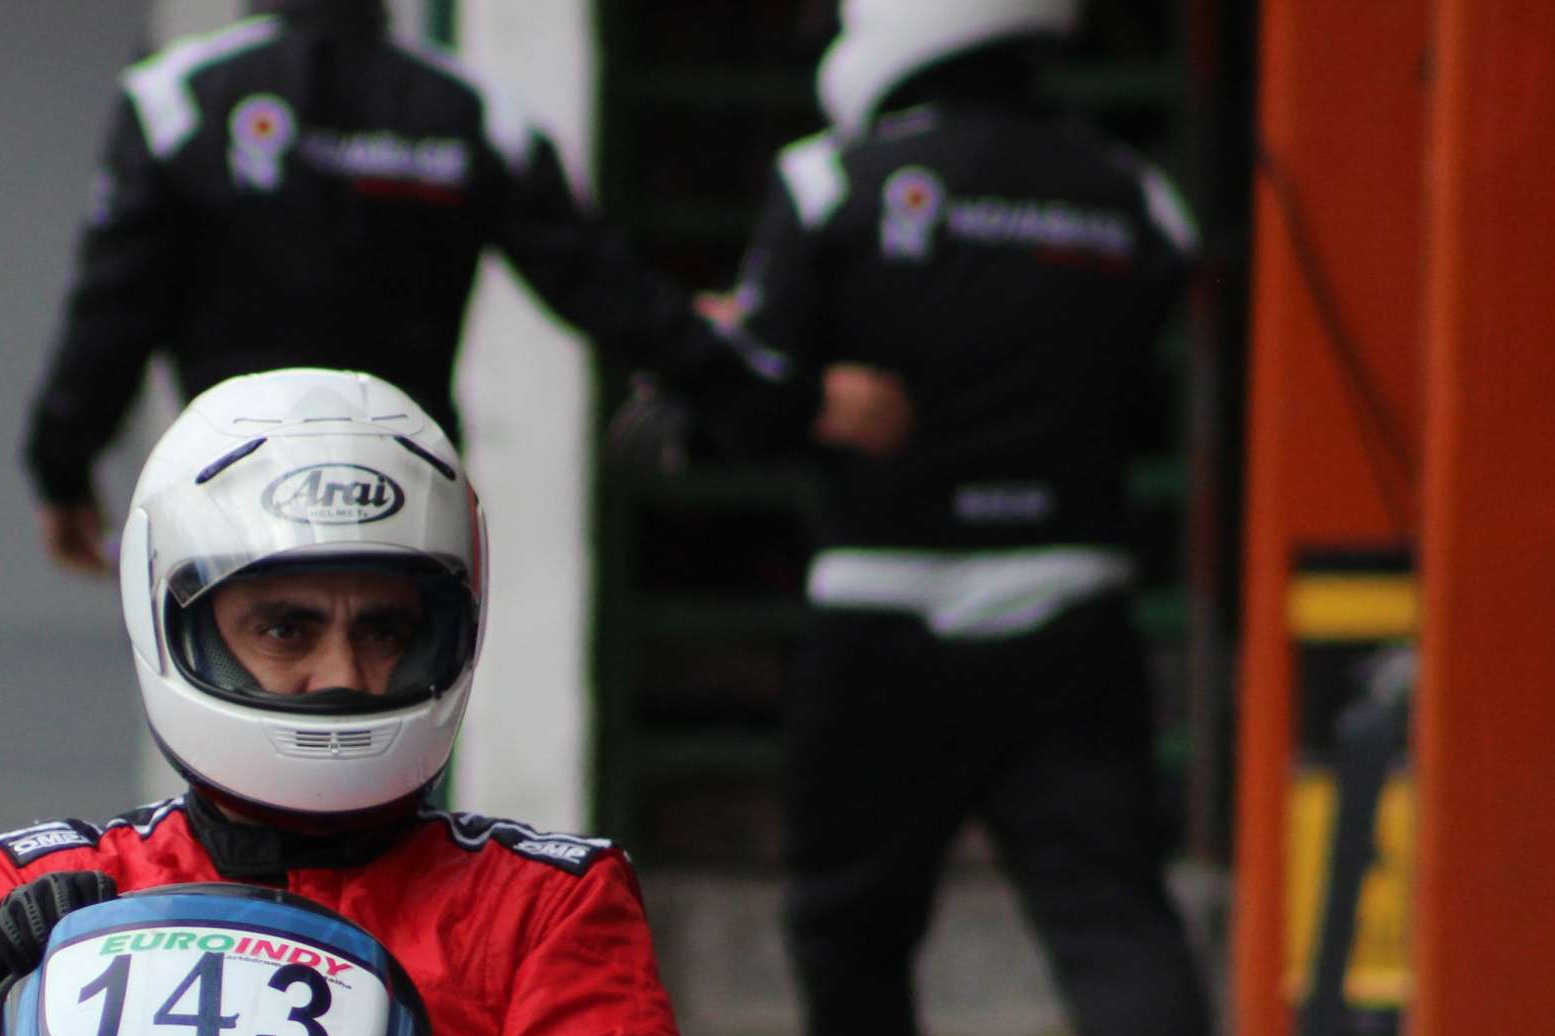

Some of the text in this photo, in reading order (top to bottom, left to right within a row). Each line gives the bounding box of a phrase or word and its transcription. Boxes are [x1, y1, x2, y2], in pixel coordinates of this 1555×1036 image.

[273, 470, 391, 507] Arai
[310, 509, 362, 518] HELMET
[99, 932, 354, 976] EUROINDY
